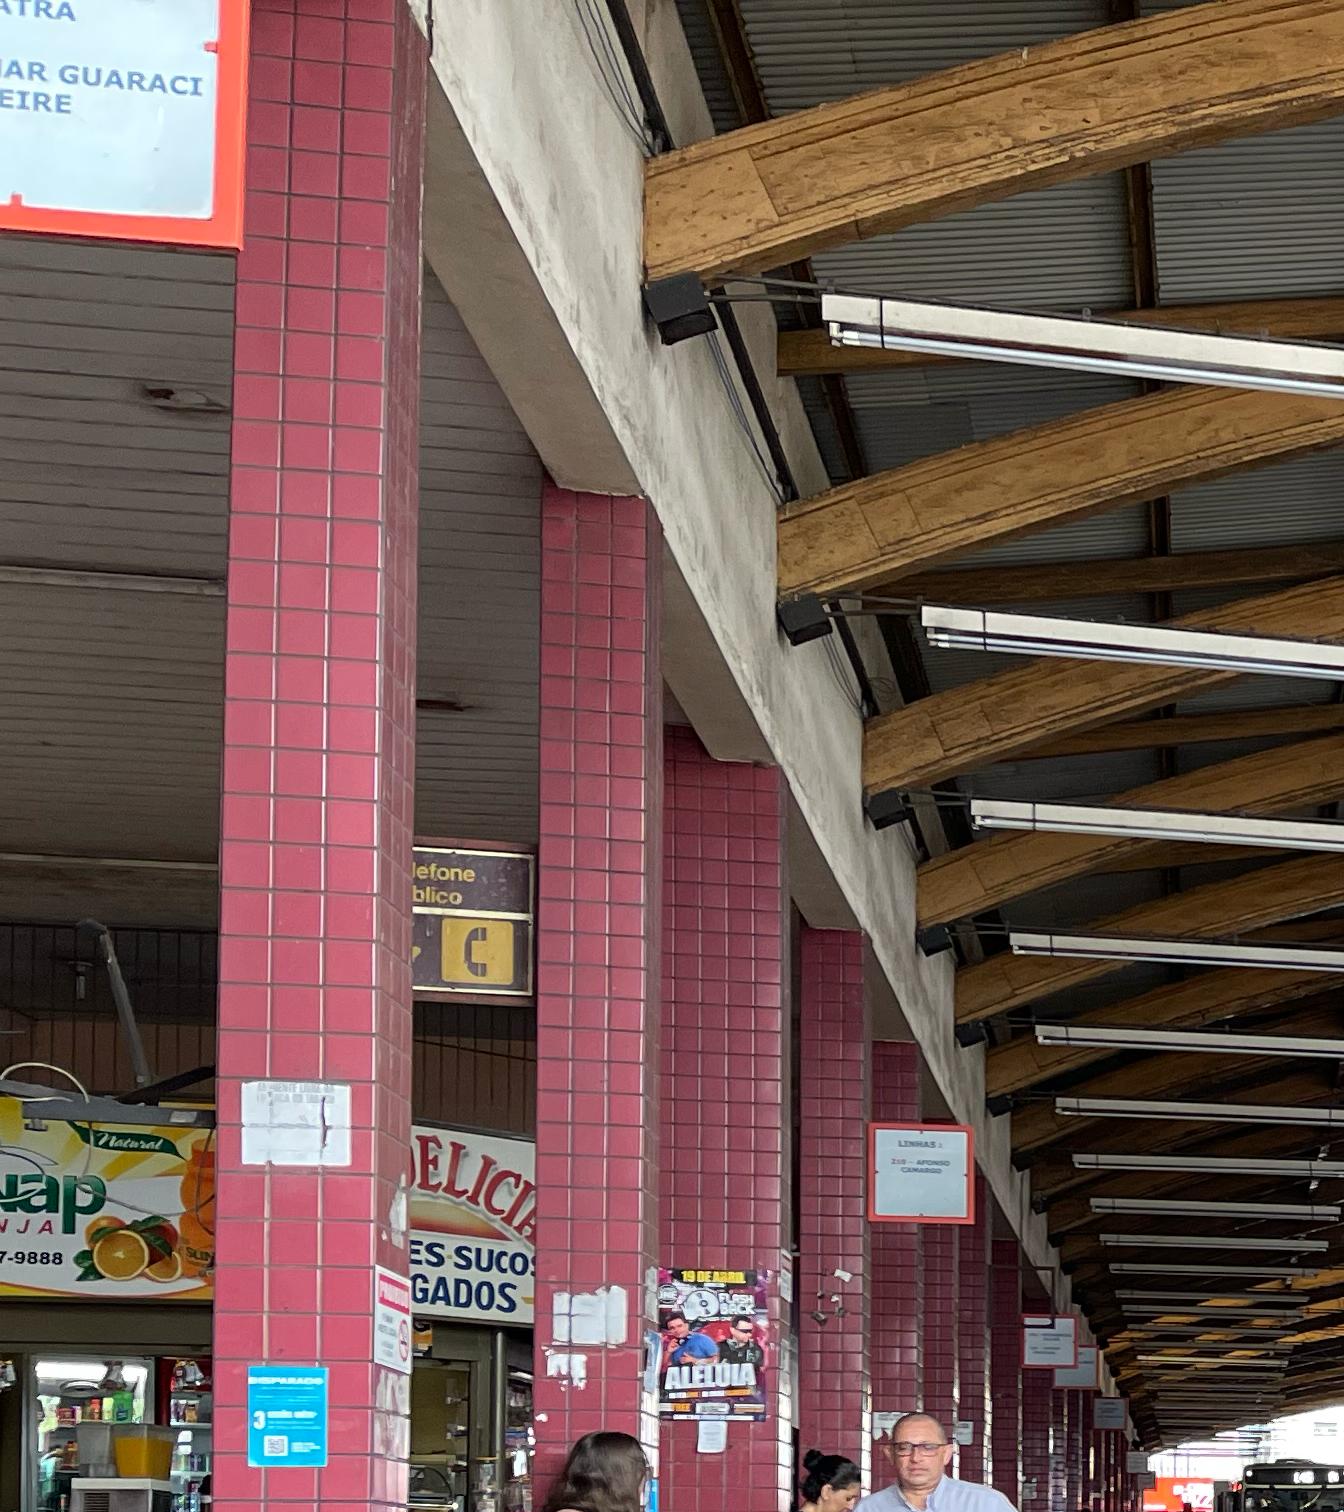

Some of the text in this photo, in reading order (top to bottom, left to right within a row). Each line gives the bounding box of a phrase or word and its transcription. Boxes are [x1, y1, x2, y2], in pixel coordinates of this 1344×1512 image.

[0, 58, 204, 97] AR GUARACI
[96, 1132, 164, 1150] Natural
[410, 1134, 536, 1246] ELICI
[411, 1273, 518, 1313] GADOS
